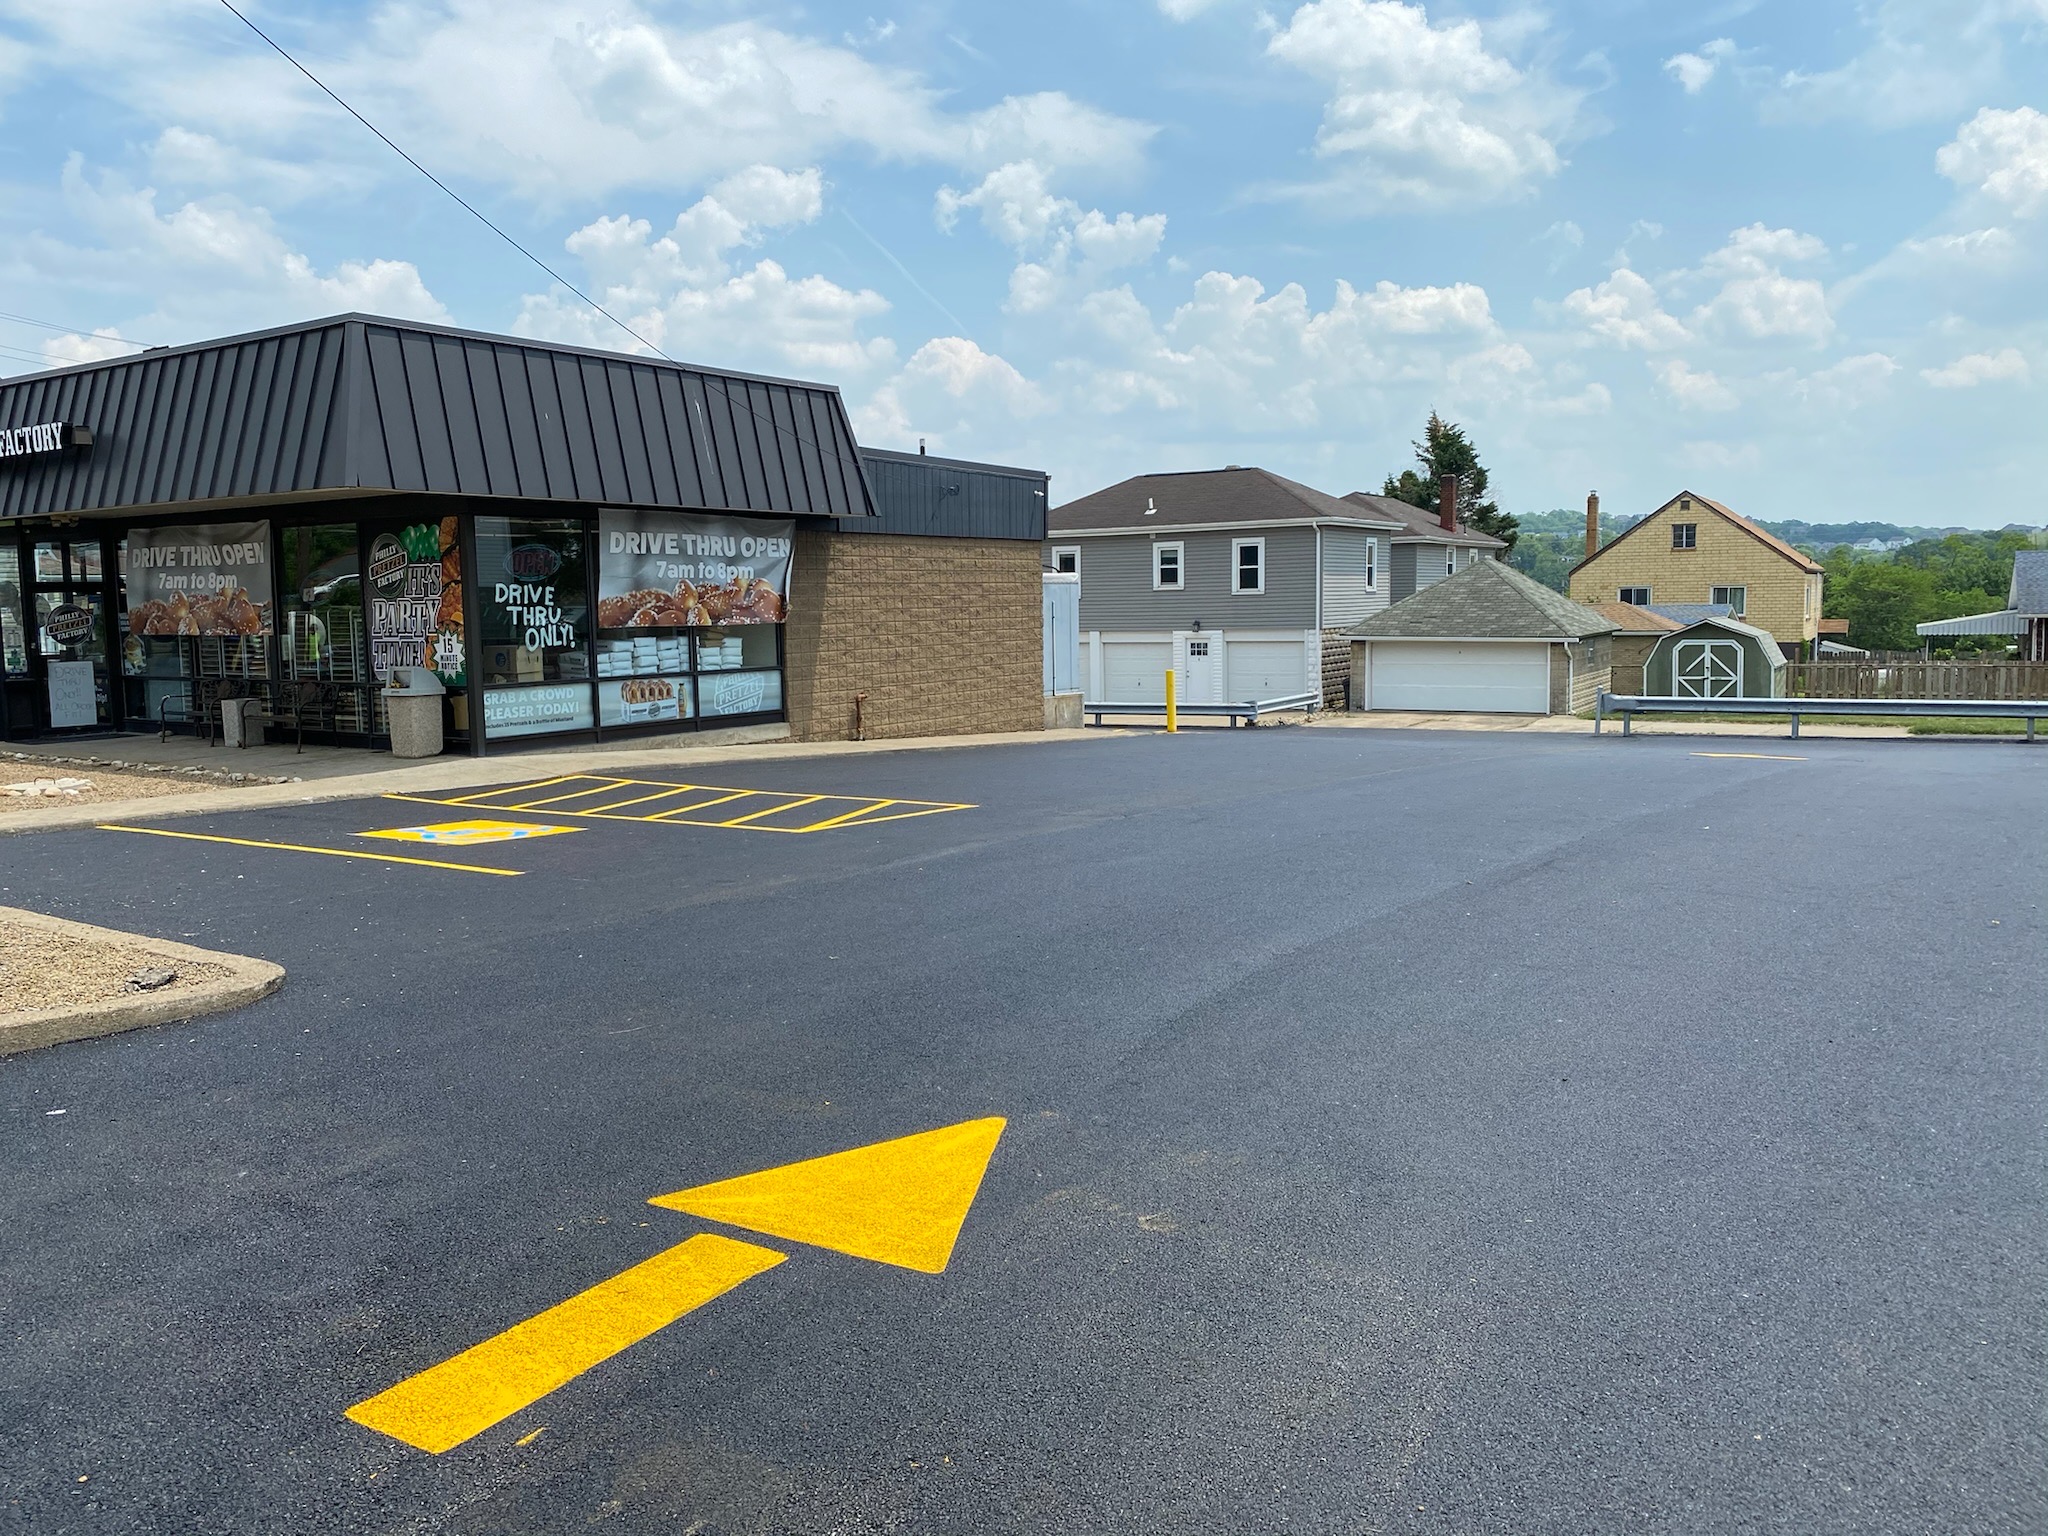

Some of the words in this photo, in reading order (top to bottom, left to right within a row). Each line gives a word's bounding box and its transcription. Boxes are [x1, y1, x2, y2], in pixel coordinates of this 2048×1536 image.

[0, 422, 62, 457] FACTORY
[375, 544, 397, 561] PHILLY
[609, 531, 680, 556] DRIVE
[682, 533, 736, 557] THRU
[740, 536, 791, 558] OPEN
[132, 546, 177, 568] DRIVE
[180, 544, 221, 567] THRU
[222, 542, 264, 566] OPEN
[513, 551, 555, 575] OPEN
[372, 554, 404, 577] PRETZEL
[656, 560, 695, 579] 7am
[698, 563, 715, 579] to
[717, 562, 755, 581] 8pm
[159, 573, 187, 589] 7am
[191, 573, 205, 589] to
[207, 572, 237, 593] 8pm
[377, 569, 404, 588] FACTORY
[405, 563, 442, 597] IT'S
[495, 583, 555, 606] DRIVE
[55, 611, 80, 622] PHILLY
[372, 598, 441, 639] PARTY
[506, 606, 562, 626] THRU
[52, 620, 88, 633] PRETZEL
[57, 628, 88, 640] FACTORY
[443, 638, 453, 653] 15
[525, 623, 576, 653] ONLY!
[440, 654, 458, 663] MINUTE
[441, 662, 458, 671] NOTICE
[54, 666, 88, 679] DRIVE
[484, 691, 516, 705] GRAB
[519, 692, 528, 702] A
[530, 687, 574, 701] CROWD
[719, 680, 760, 705] PRETZEL
[485, 706, 534, 720] PLEASER
[536, 702, 579, 716] TODAY!
[724, 696, 759, 714] FACTORY
